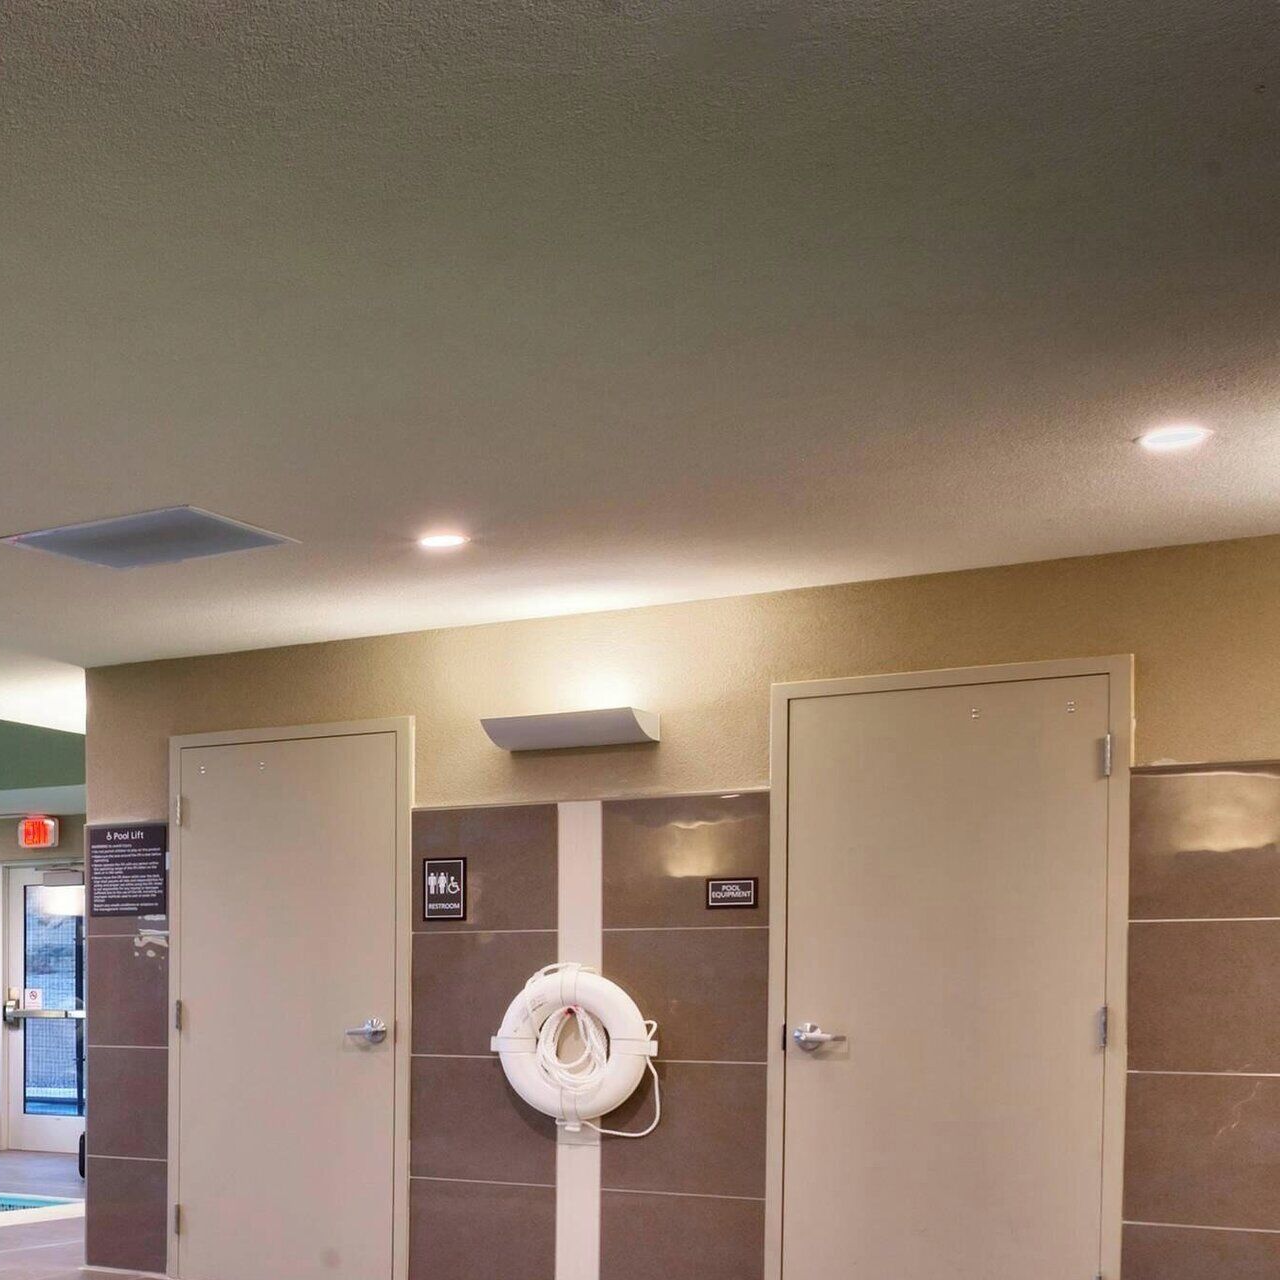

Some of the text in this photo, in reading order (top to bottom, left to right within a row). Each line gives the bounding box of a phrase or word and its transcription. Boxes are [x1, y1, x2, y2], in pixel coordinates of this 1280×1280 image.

[113, 831, 144, 840] Pool Lift
[711, 891, 752, 899] EQUIPMENT
